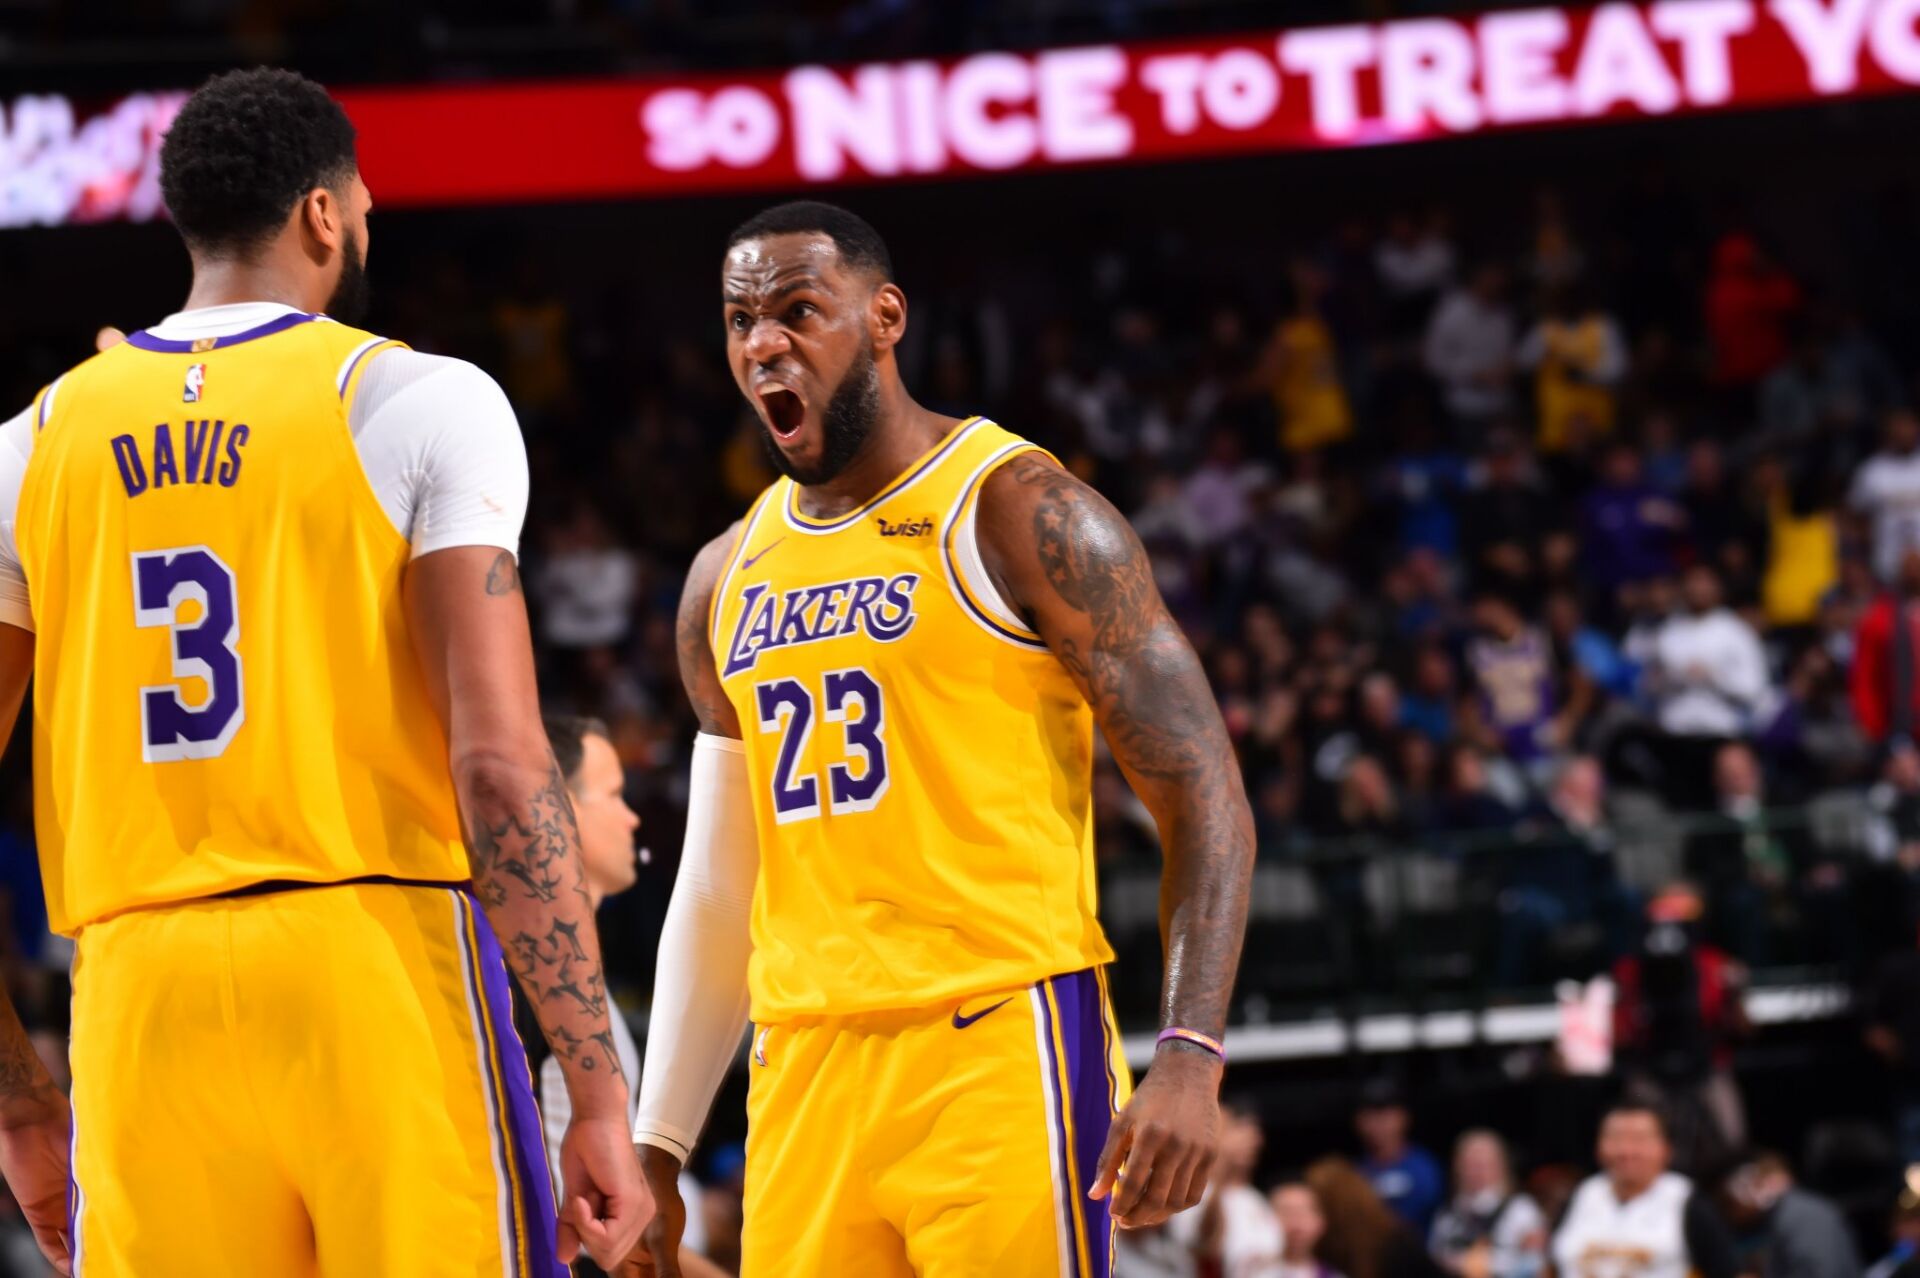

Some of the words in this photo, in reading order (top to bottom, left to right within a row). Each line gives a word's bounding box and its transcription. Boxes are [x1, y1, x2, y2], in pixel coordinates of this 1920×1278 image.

[640, 88, 780, 171] SO
[784, 46, 1133, 180] NICE
[1140, 49, 1280, 134] TO
[1277, 0, 1755, 140] TREAT
[110, 420, 250, 498] DAVIS
[877, 517, 934, 537] wish
[130, 544, 247, 764] 3
[722, 572, 921, 681] LAKERS
[754, 666, 890, 826] 23
